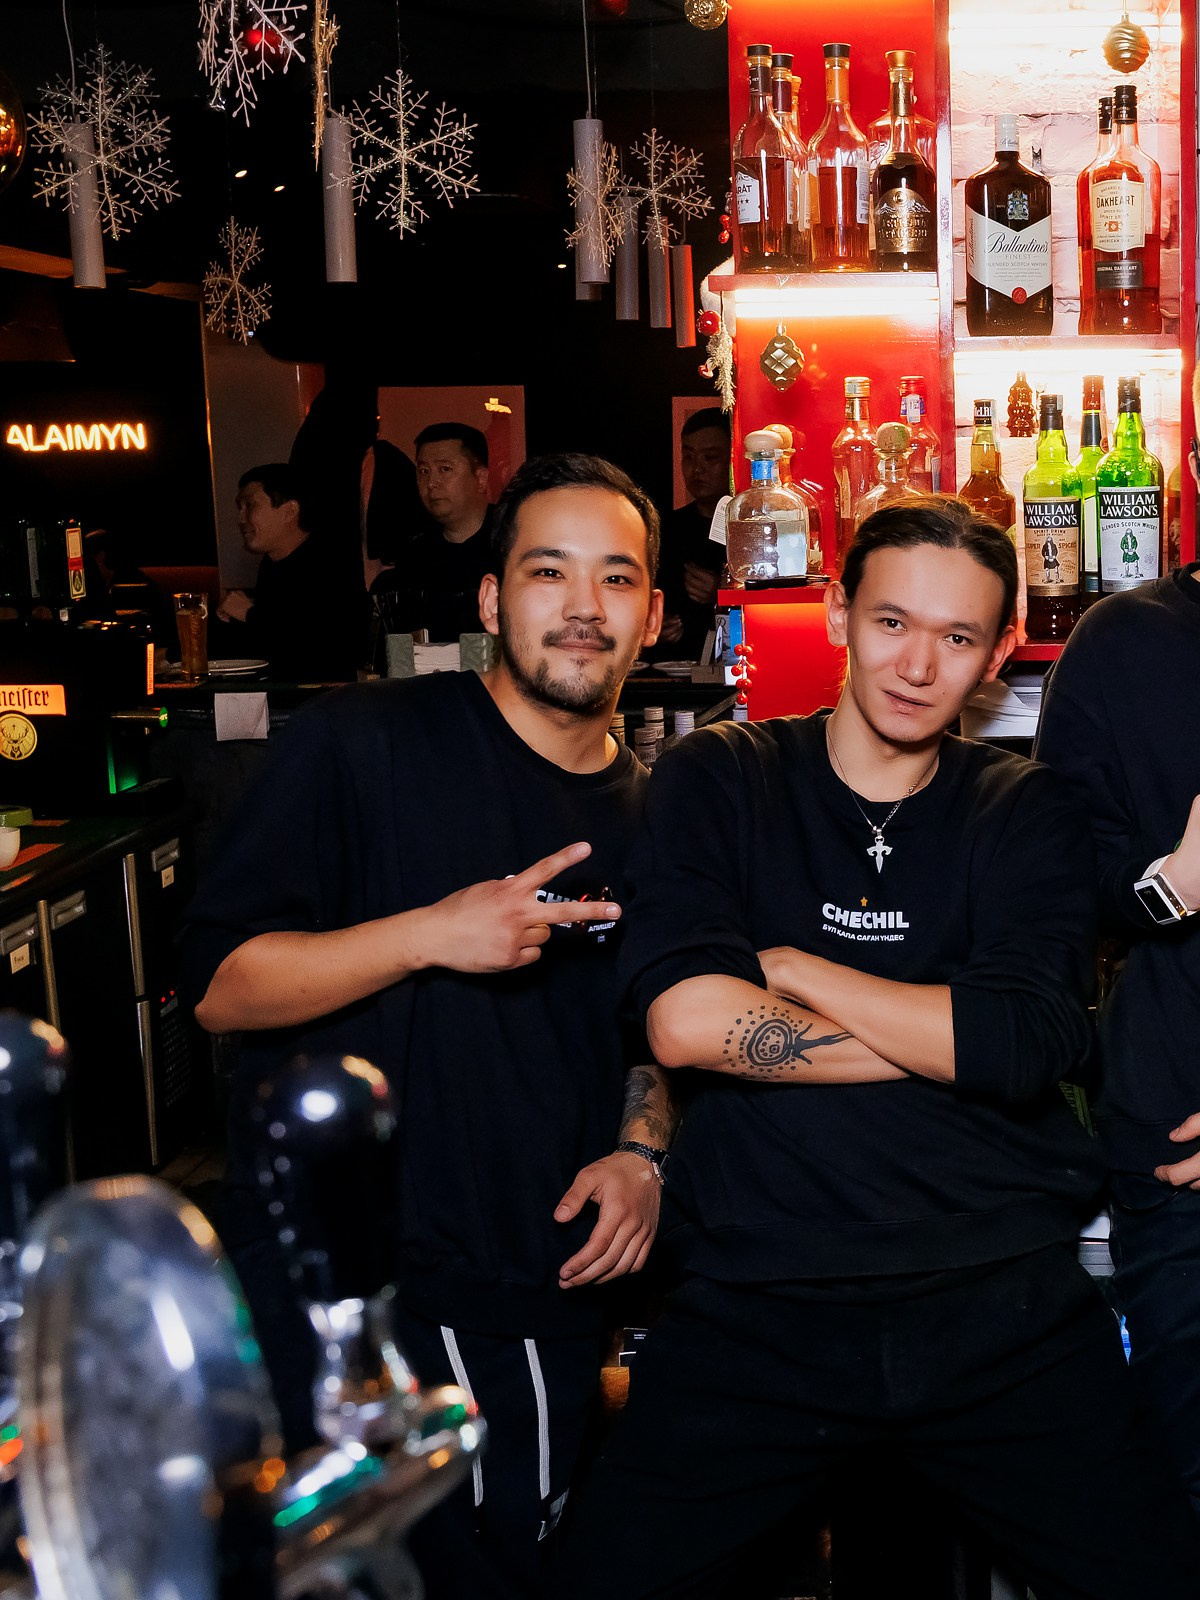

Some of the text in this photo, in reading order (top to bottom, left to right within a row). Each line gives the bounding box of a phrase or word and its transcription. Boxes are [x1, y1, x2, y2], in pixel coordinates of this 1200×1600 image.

[1096, 195, 1135, 208] OAKHEART
[984, 231, 1049, 254] Ballantine's
[6, 423, 146, 451] ALAIMYN
[1102, 493, 1155, 505] WILLIAM
[1025, 503, 1075, 516] WILLIAM
[1100, 504, 1158, 517] LAWSON'S
[1025, 514, 1078, 526] LAWSON'S
[1101, 522, 1120, 532] BLENDED
[822, 902, 910, 929] CHECHIL
